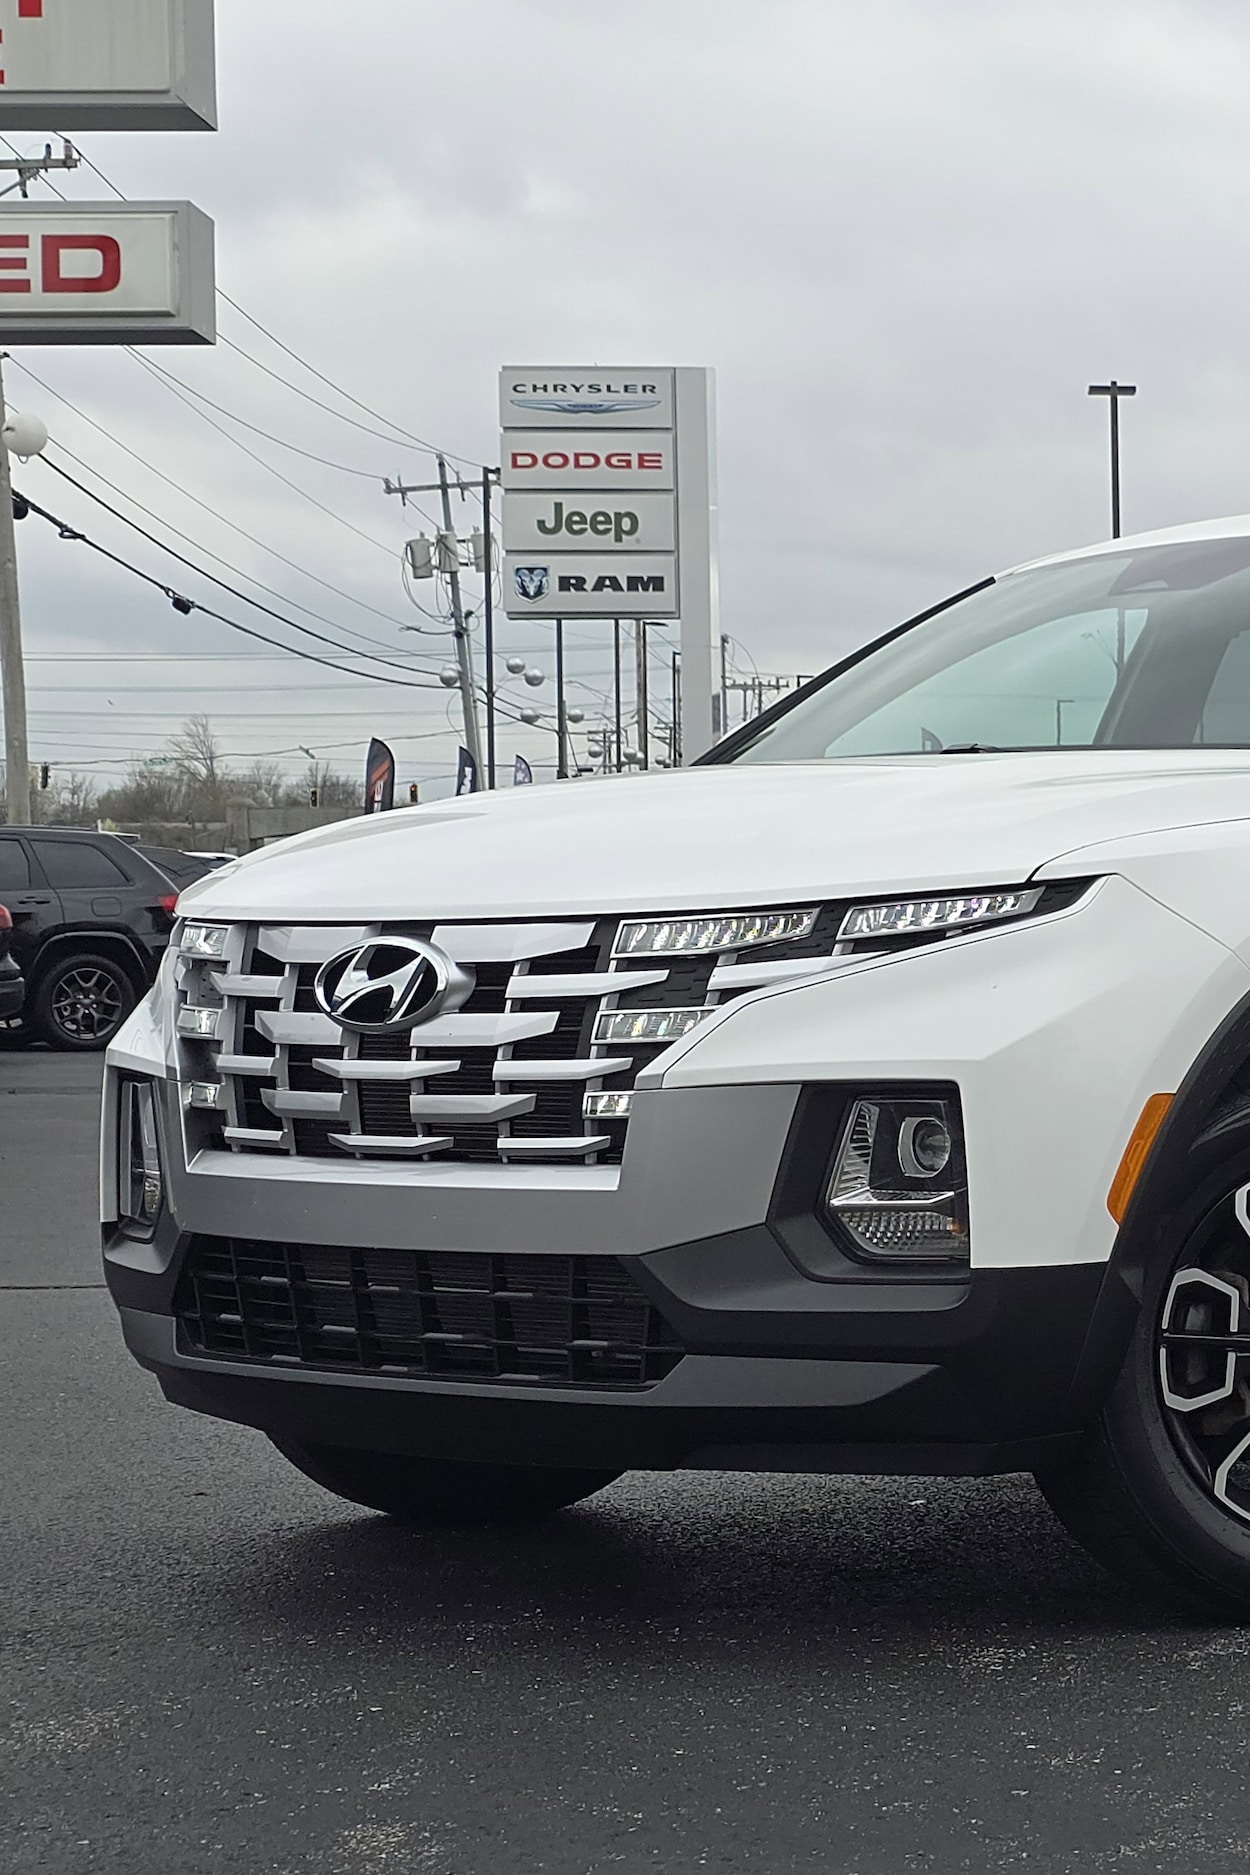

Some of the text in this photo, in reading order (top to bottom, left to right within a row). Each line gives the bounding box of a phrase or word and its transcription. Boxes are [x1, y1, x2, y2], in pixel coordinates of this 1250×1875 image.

[512, 383, 657, 394] CHRYSLER
[511, 452, 663, 469] DODGE
[536, 502, 639, 543] Jeep
[558, 575, 665, 592] RAM
